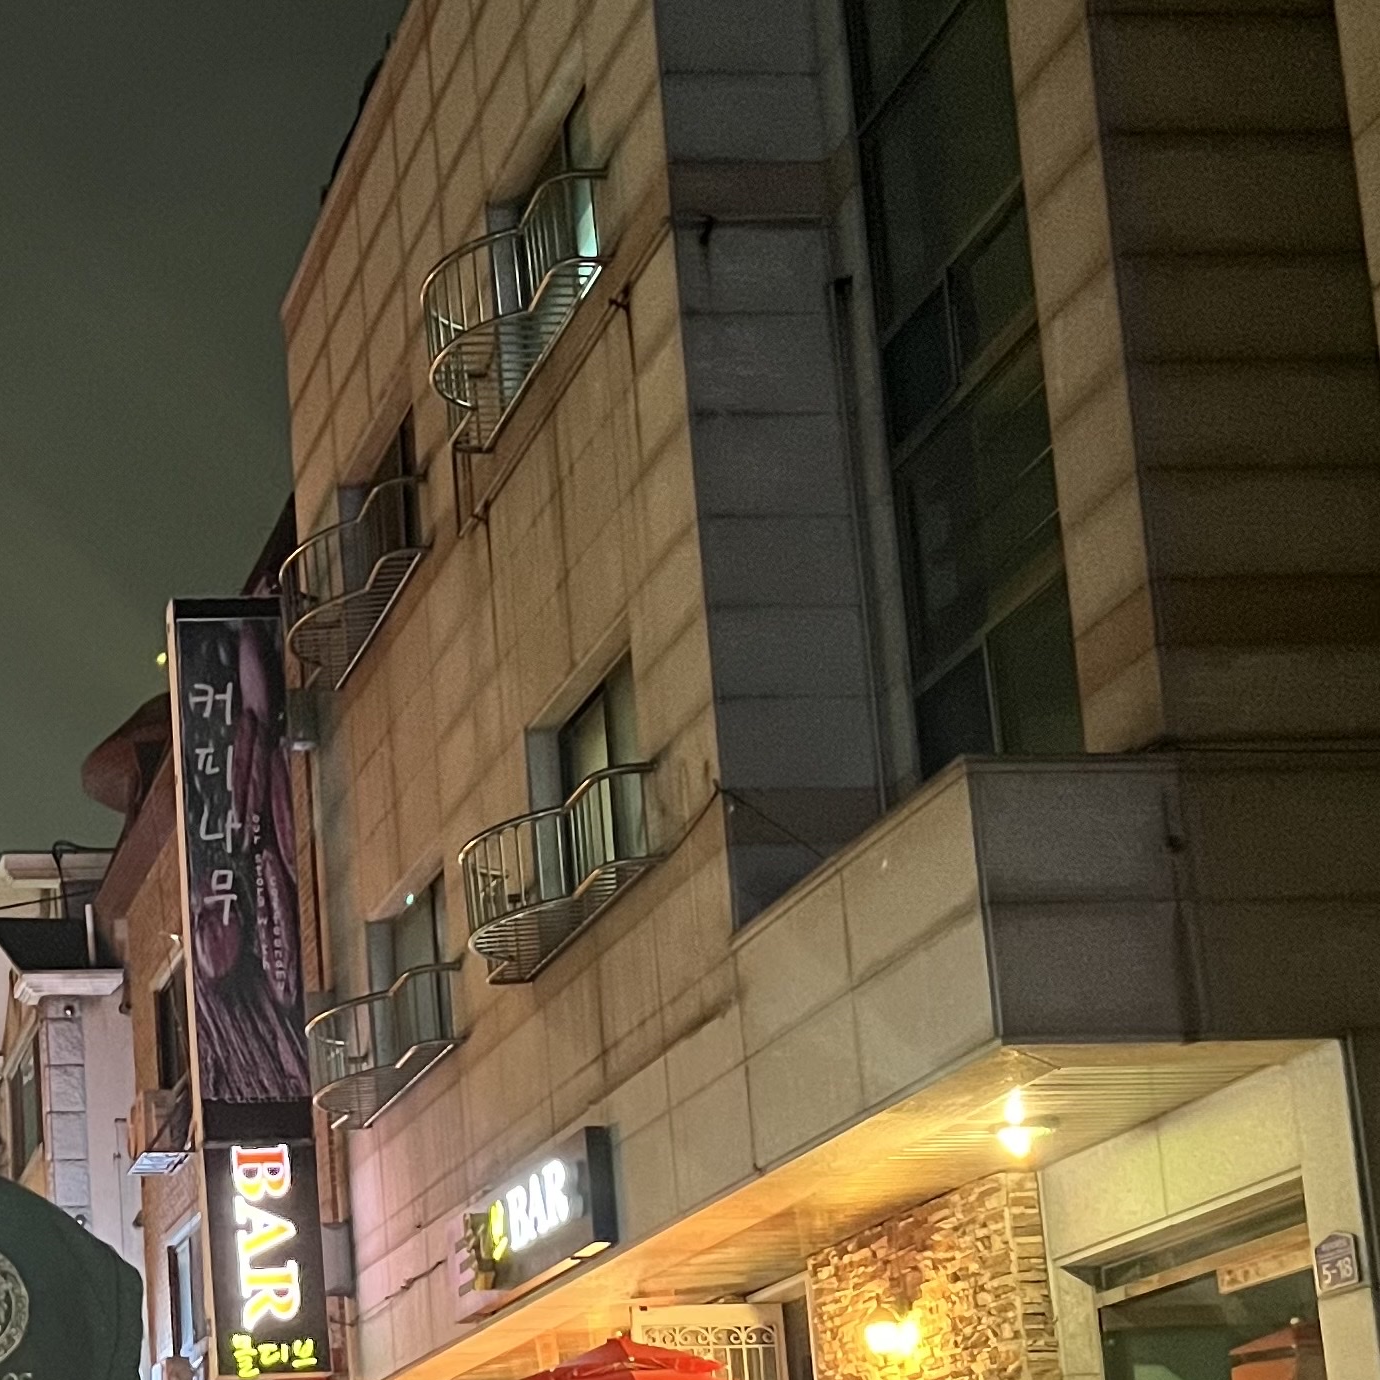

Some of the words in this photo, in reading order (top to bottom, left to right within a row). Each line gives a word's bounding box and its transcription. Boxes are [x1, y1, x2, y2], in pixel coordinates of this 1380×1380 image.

[189, 682, 242, 926] 커피나무
[231, 1143, 303, 1332] BAR
[505, 1159, 570, 1252] BAR
[231, 1334, 319, 1379] 몰디브
